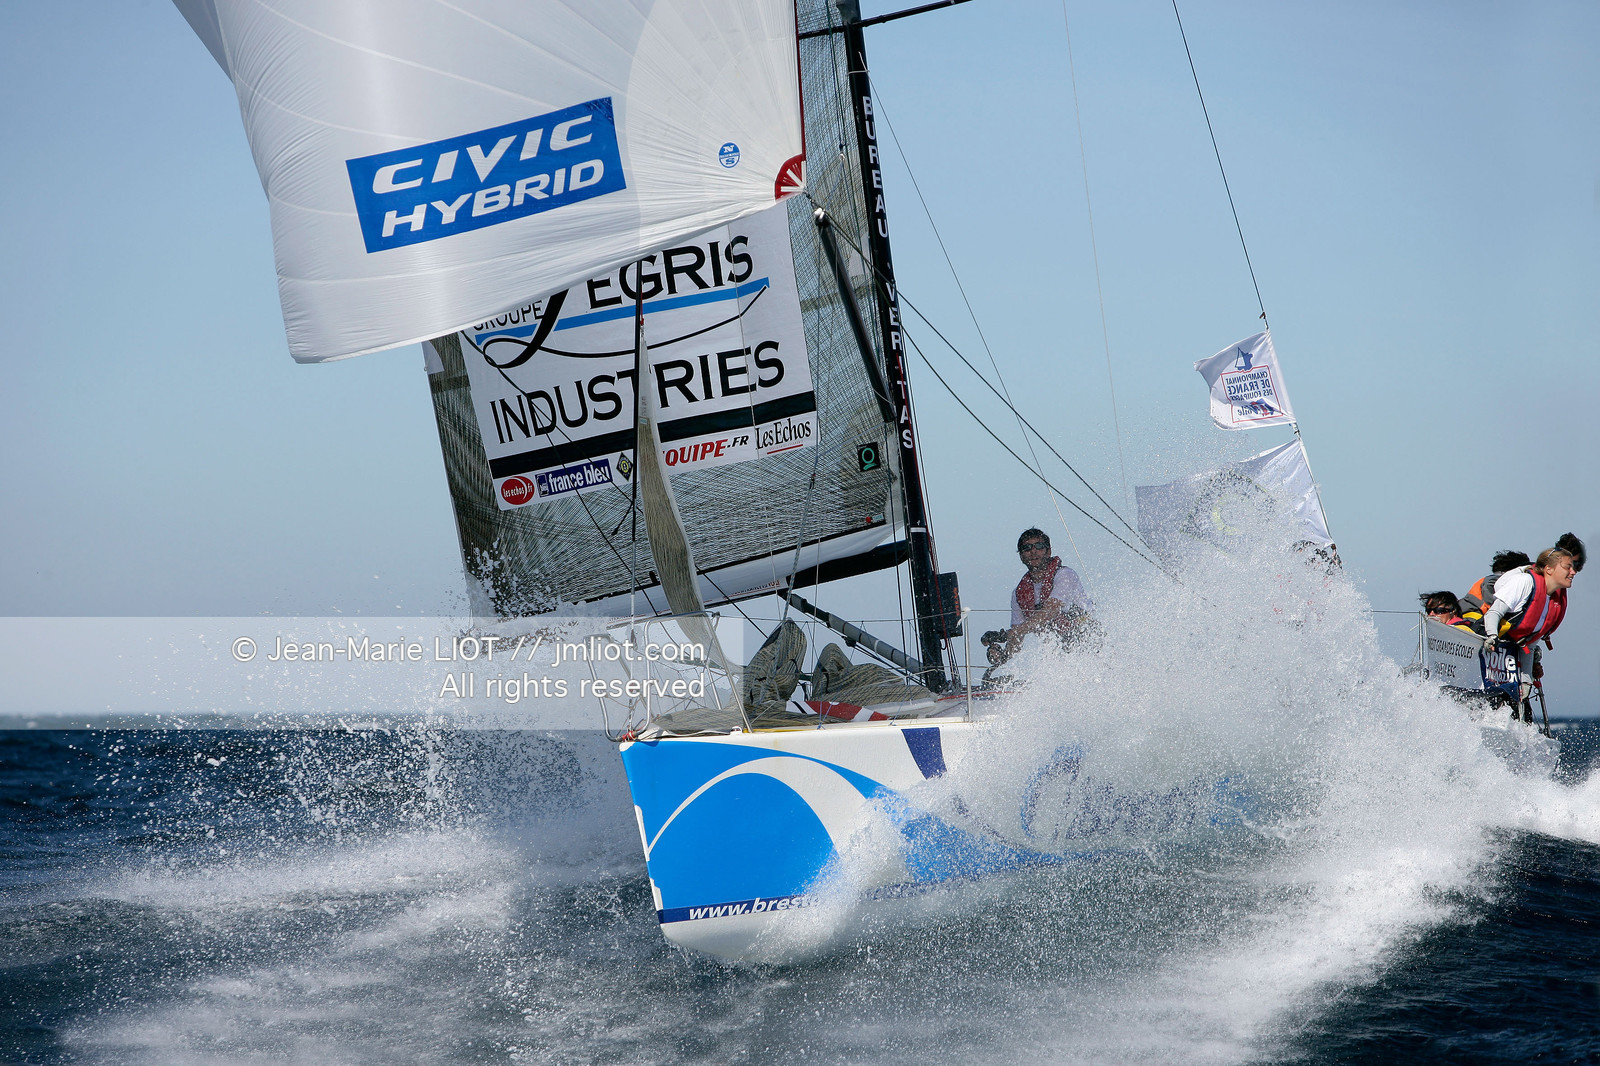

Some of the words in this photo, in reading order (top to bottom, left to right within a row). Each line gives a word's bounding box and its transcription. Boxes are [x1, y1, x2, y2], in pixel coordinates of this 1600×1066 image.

[372, 114, 593, 194] CIVIC
[381, 159, 604, 237] HYBRID
[862, 96, 888, 238] BUREAU
[885, 282, 914, 448] VERITAS
[549, 471, 584, 493] france
[583, 465, 610, 486] bleu
